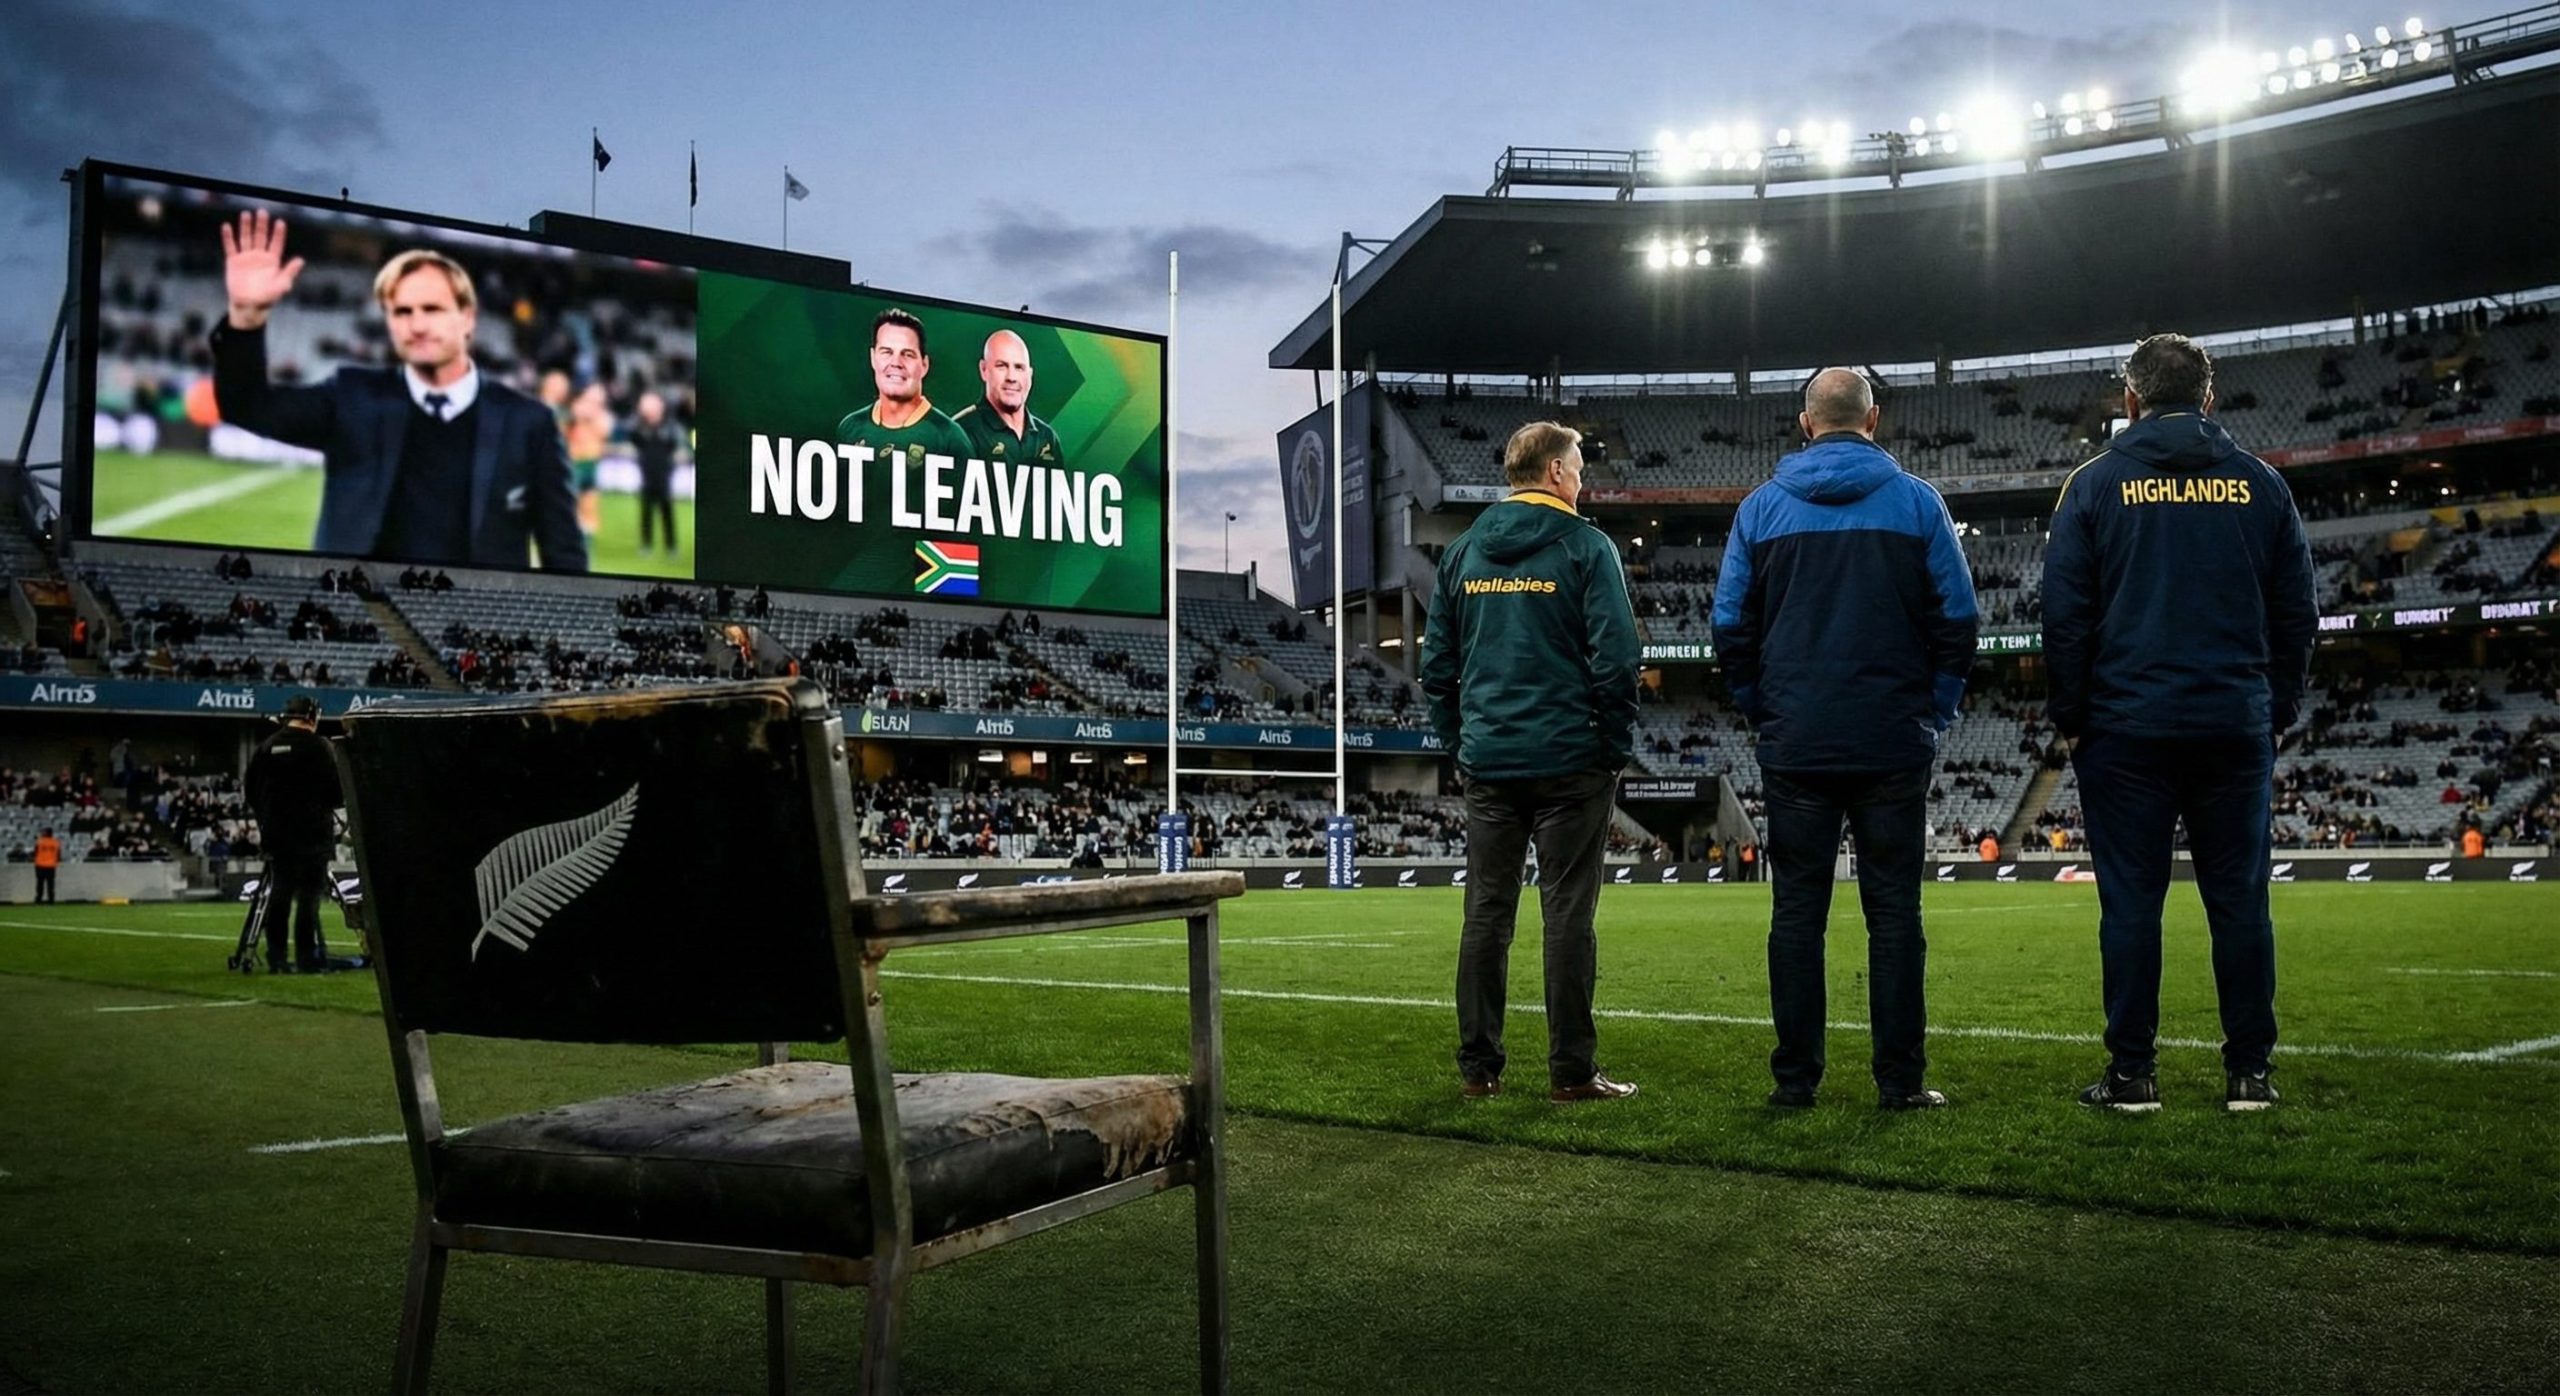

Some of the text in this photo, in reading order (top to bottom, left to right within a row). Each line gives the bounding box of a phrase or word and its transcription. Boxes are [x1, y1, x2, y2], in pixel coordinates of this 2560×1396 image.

[750, 433, 1123, 547] NOT LEAVING
[2121, 478, 2251, 506] HIGHLANDES
[1464, 577, 1557, 595] Wallabies
